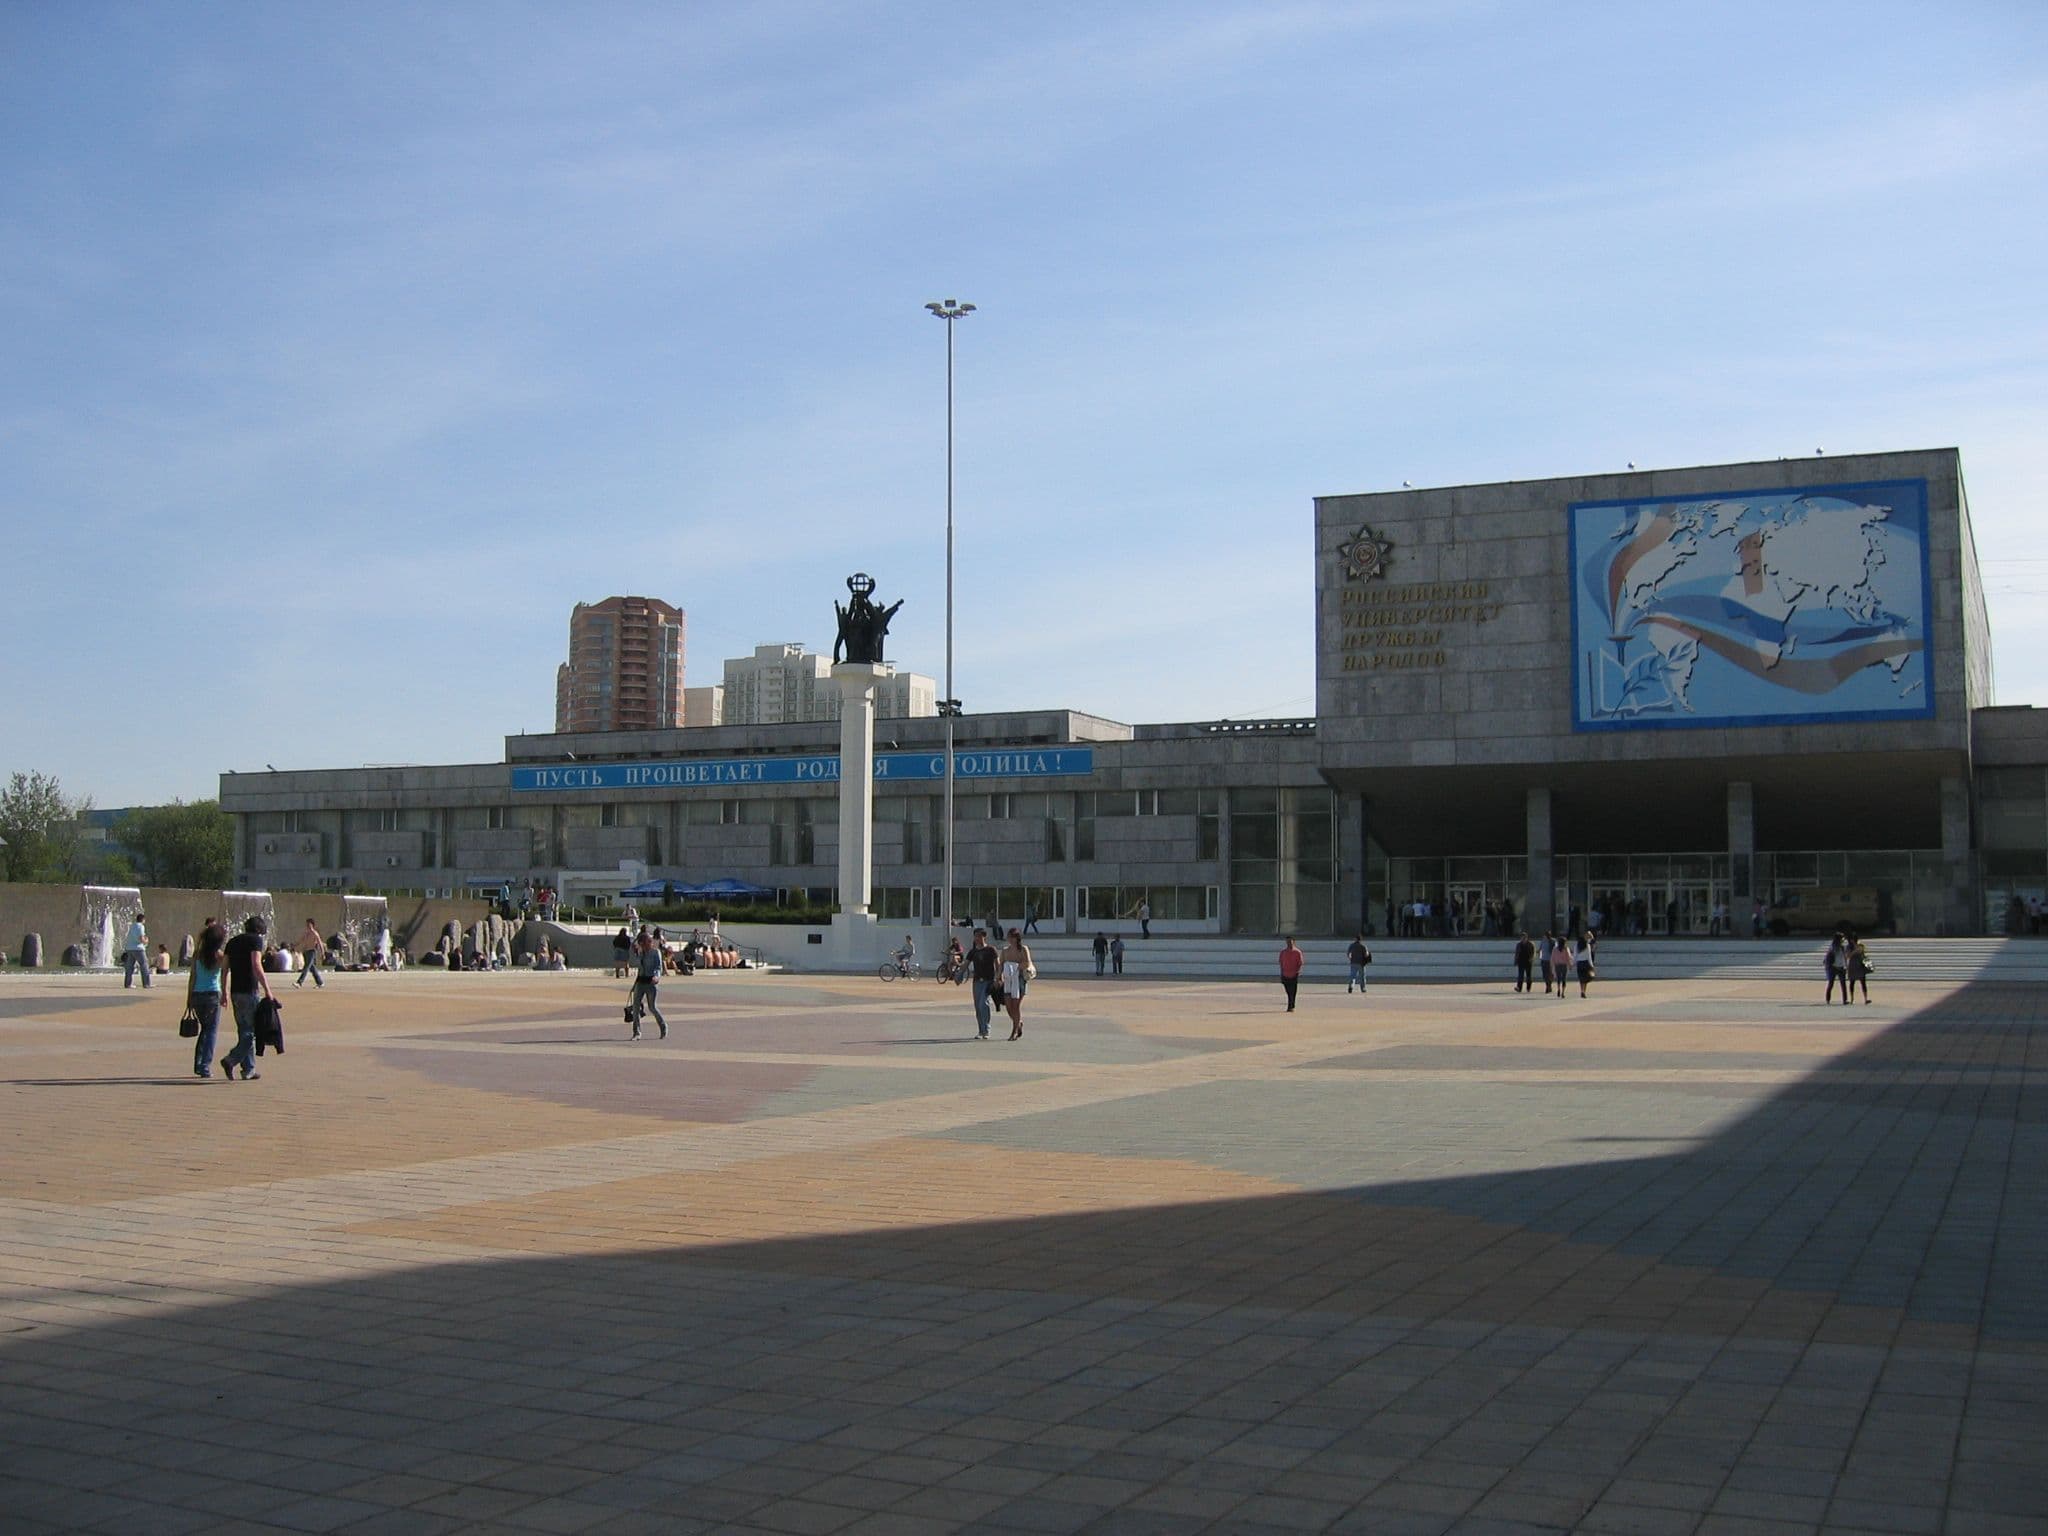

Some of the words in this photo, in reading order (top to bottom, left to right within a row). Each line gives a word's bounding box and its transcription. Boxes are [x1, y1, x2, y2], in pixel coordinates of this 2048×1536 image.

[536, 770, 603, 787] ПУСТЬ
[626, 763, 767, 784] ПРОЦВЕТАЕТ
[796, 758, 888, 779] РОДЯ
